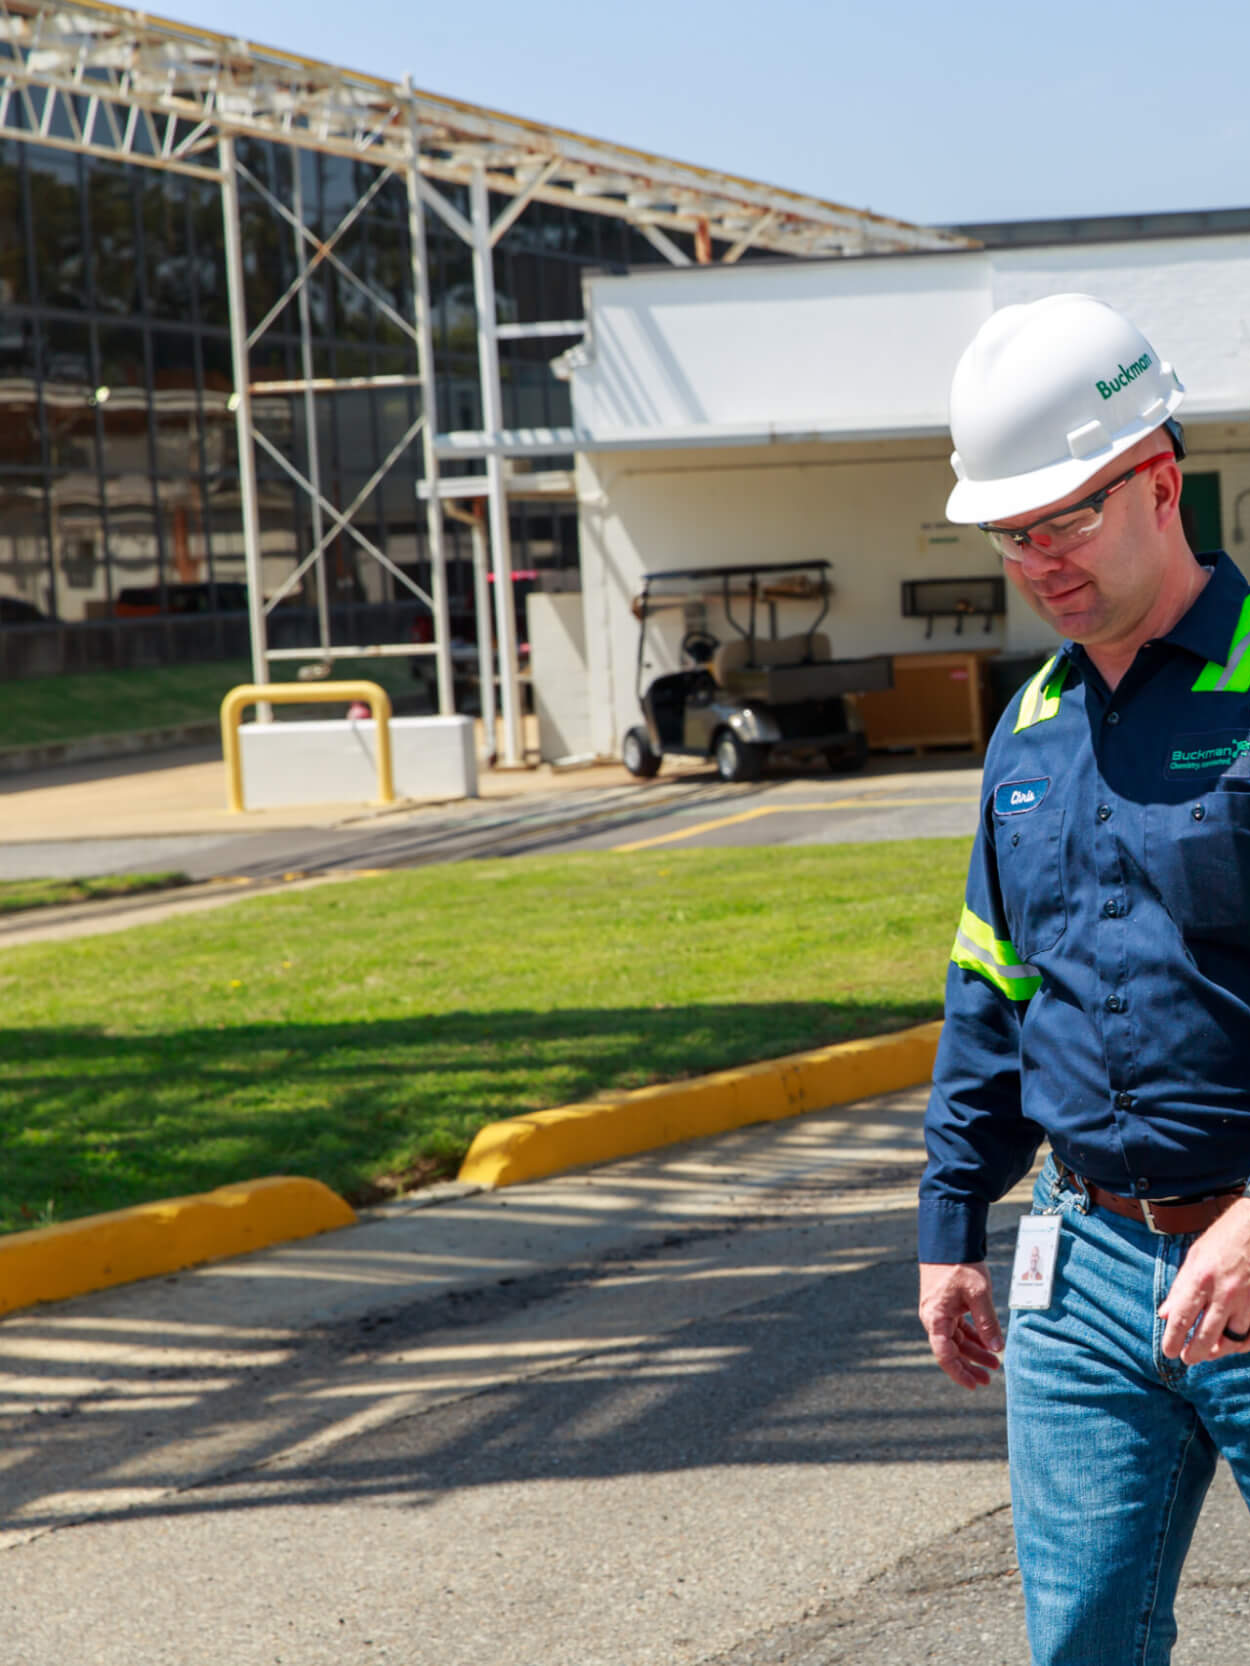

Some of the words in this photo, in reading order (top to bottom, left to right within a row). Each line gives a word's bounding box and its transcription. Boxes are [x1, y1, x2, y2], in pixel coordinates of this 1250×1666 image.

[1095, 353, 1153, 400] Buckman
[1172, 747, 1232, 761] Buckman
[1011, 790, 1034, 805] Chris
